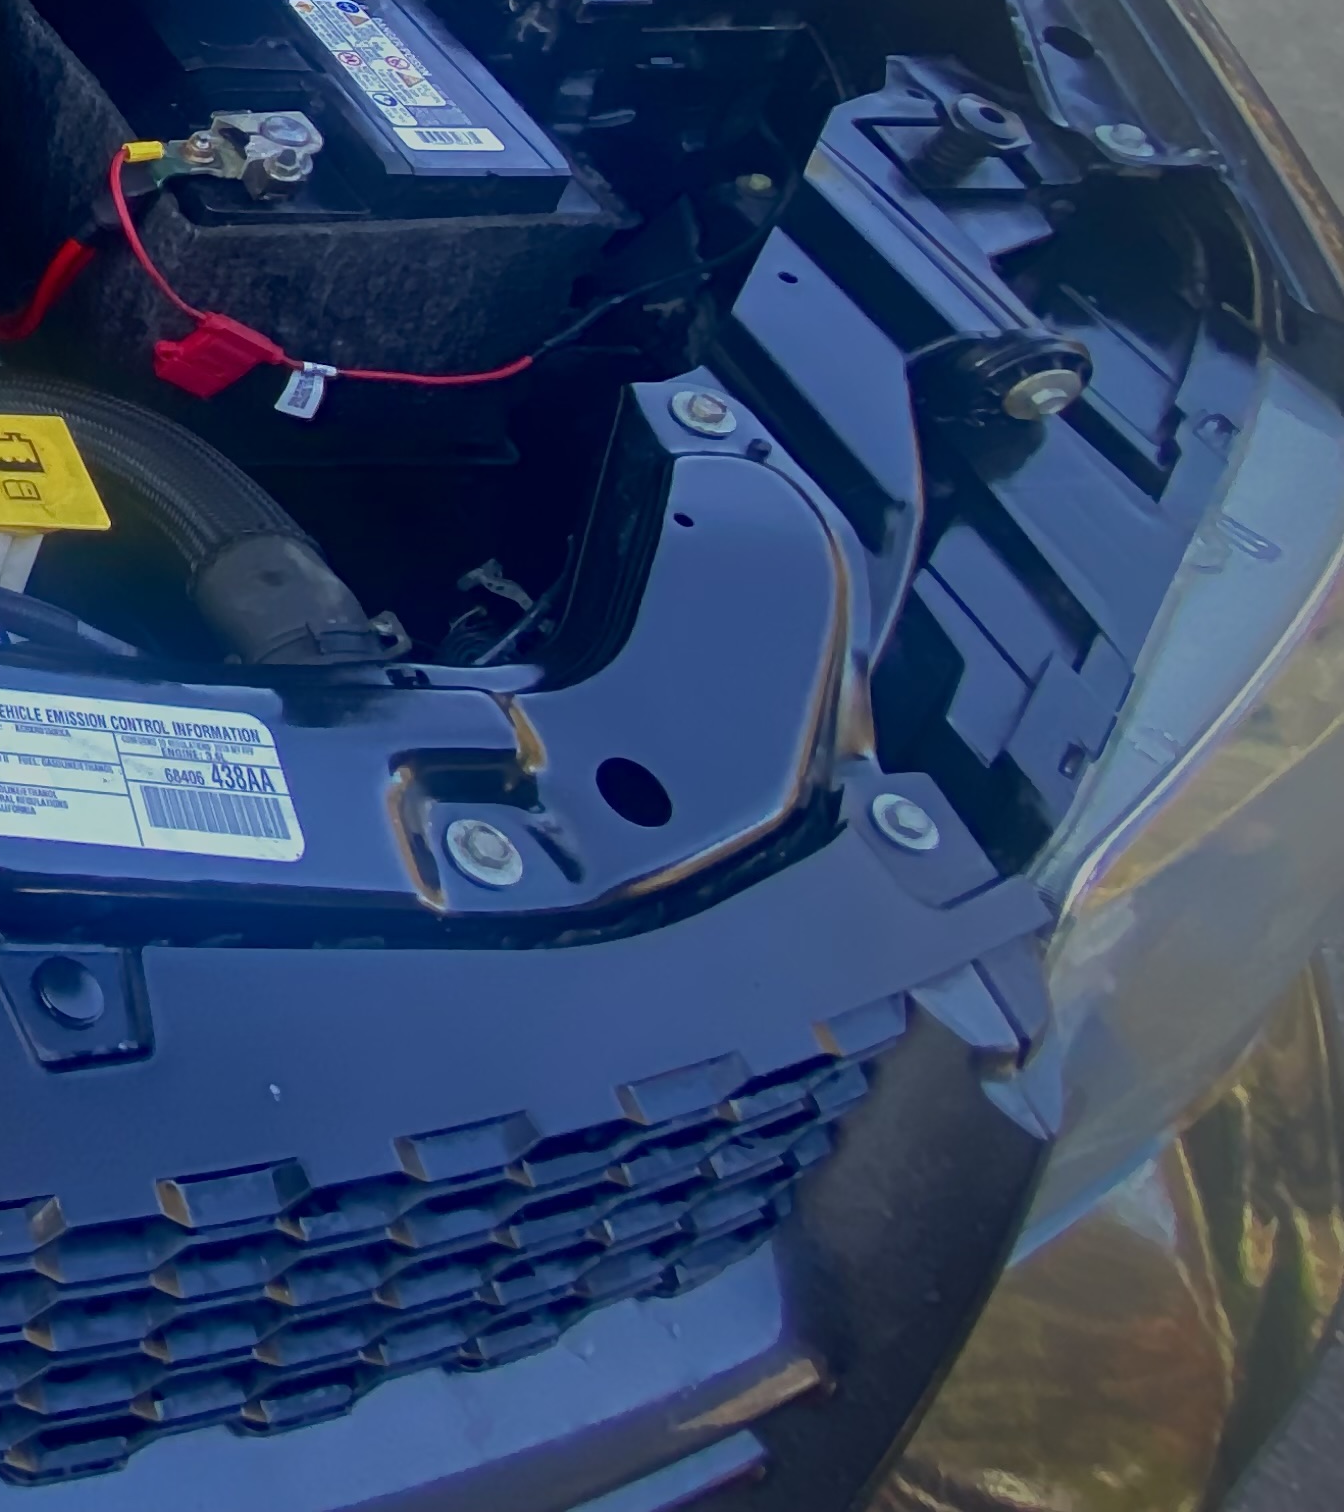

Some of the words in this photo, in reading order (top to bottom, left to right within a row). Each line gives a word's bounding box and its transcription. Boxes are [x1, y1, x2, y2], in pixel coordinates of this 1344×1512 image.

[46, 707, 107, 729] EMISSION
[110, 716, 170, 735] CONTROL
[171, 721, 261, 744] INFORMATION
[164, 767, 205, 786] 68406
[211, 762, 276, 793] 438AA
